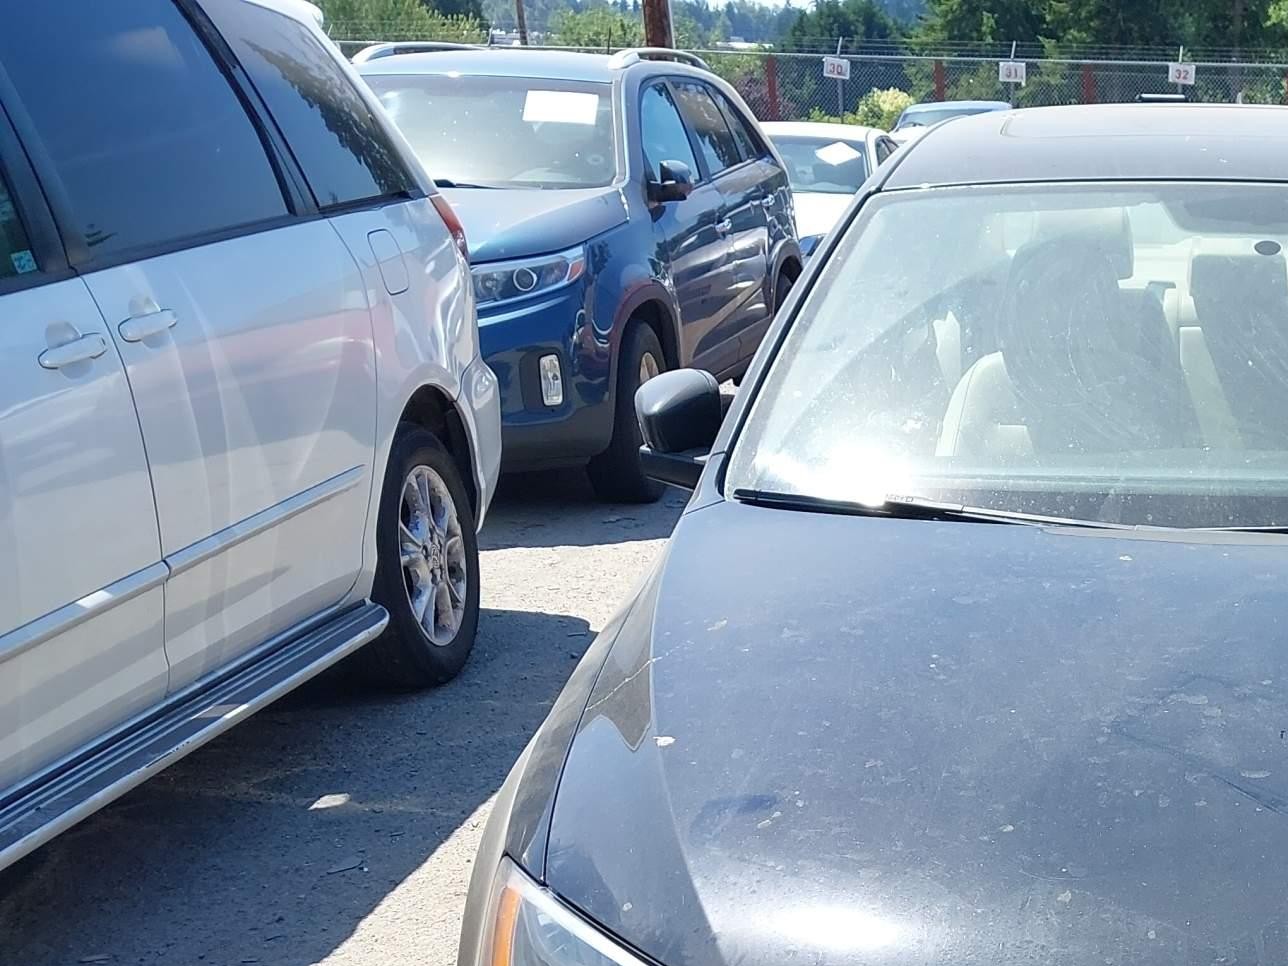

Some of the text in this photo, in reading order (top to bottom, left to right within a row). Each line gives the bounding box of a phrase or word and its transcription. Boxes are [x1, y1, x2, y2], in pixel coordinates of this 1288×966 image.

[829, 63, 843, 75] 30
[1005, 64, 1018, 79] 31
[1175, 69, 1190, 81] 32
